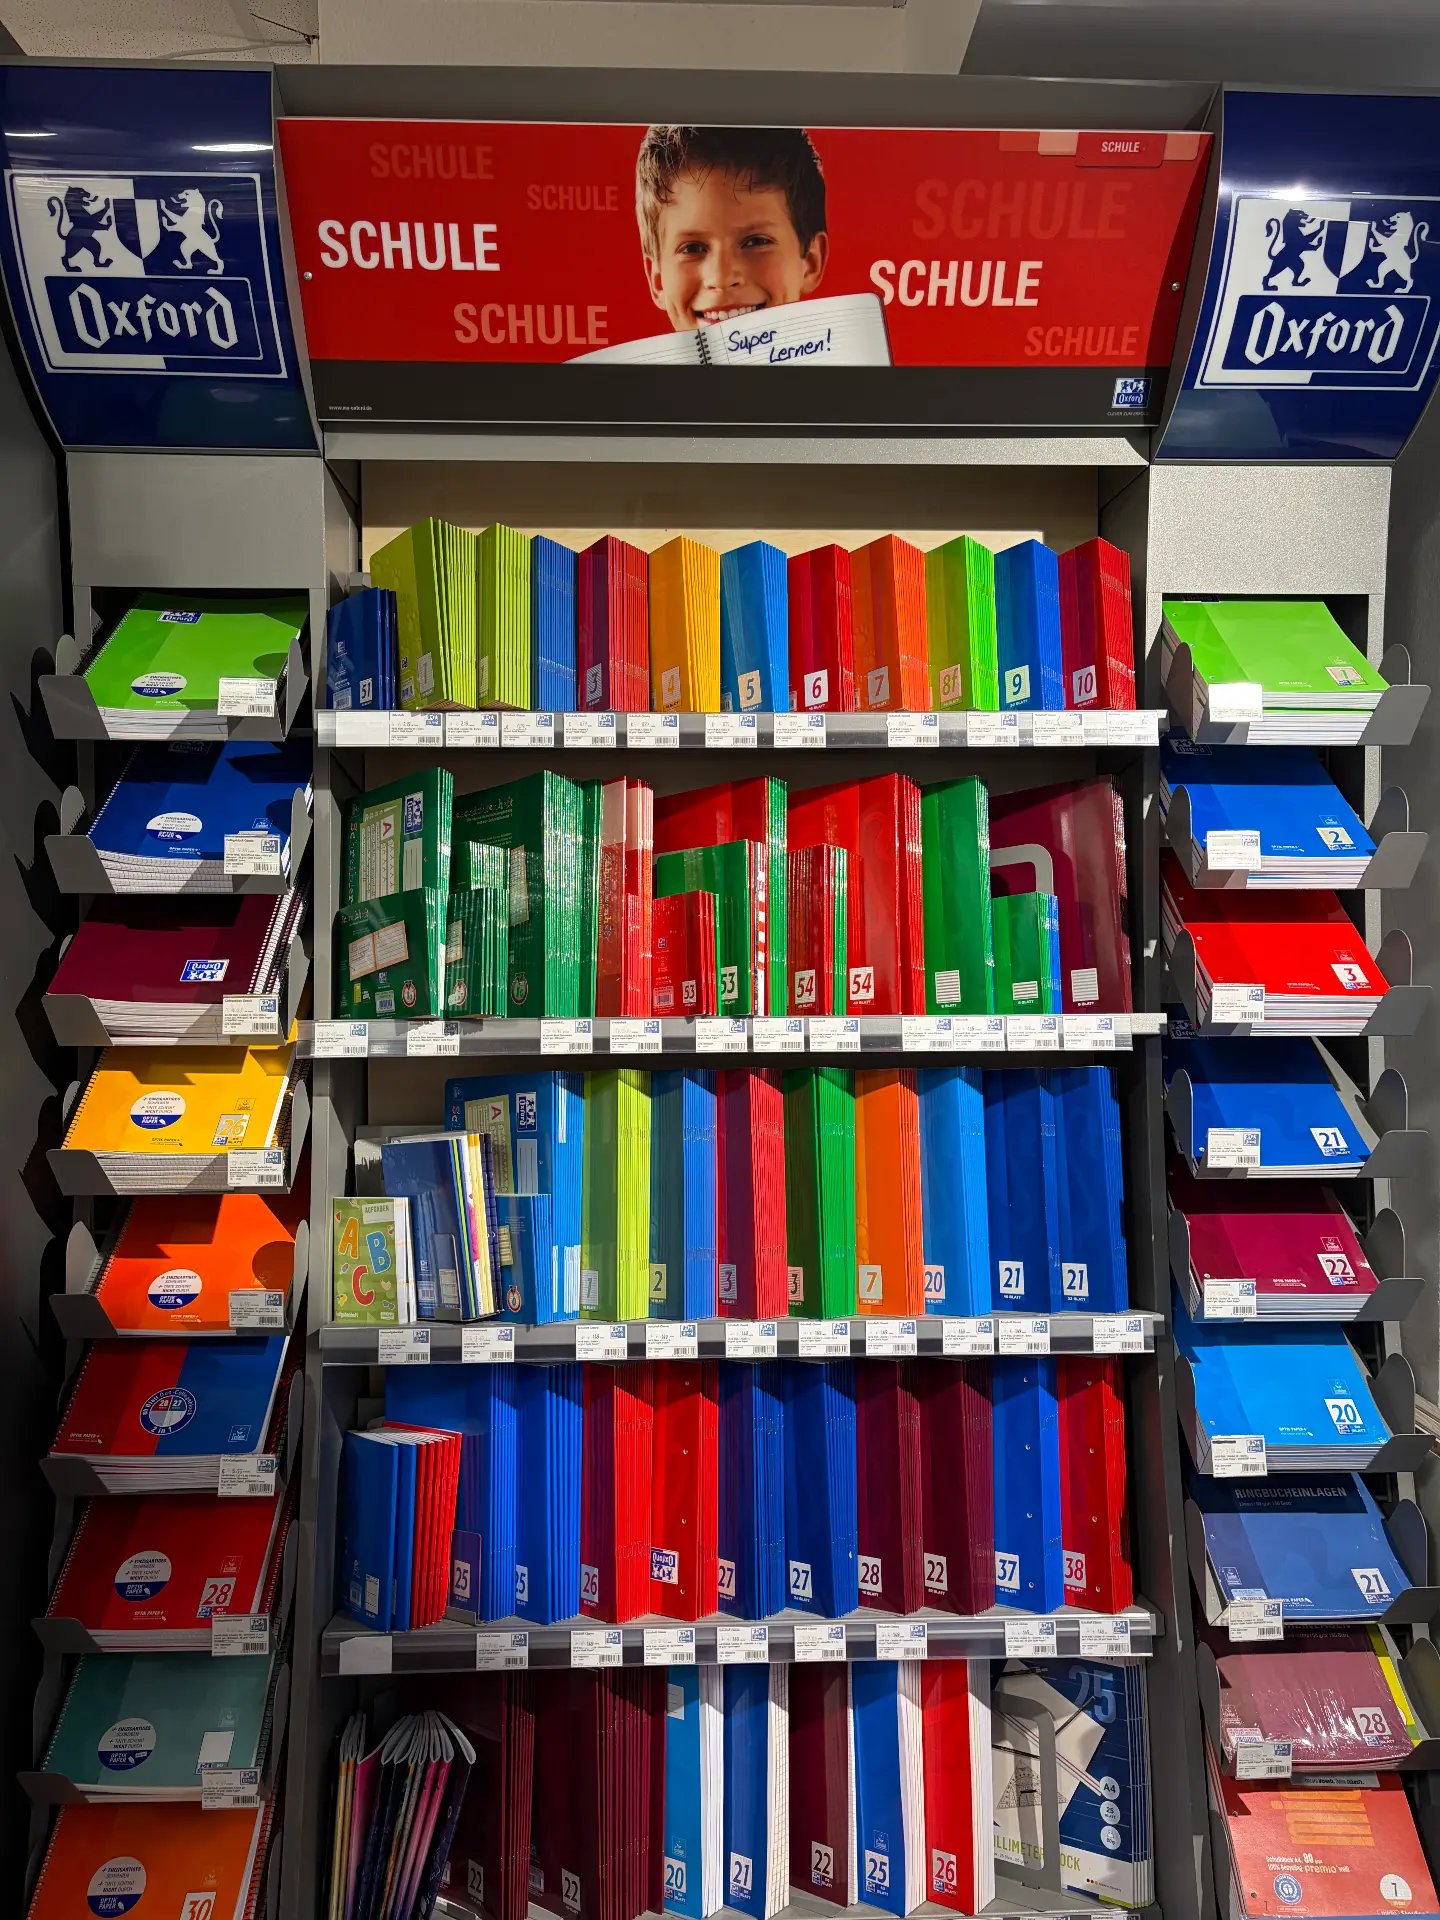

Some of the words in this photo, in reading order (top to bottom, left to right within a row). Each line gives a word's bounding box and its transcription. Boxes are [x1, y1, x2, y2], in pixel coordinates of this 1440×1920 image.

[1101, 140, 1141, 154] SCHULE
[368, 143, 494, 181] SCHULE
[526, 184, 620, 212] SCHULE
[911, 178, 1131, 240] SCHULE
[318, 219, 500, 271] SCHULE
[869, 258, 1043, 308] SCHULE
[68, 283, 239, 350] Oxford
[453, 301, 609, 345] SCHULE
[727, 329, 777, 356] Super
[769, 330, 832, 363] Lernen!
[1023, 324, 1140, 358] SCHULE
[1243, 304, 1405, 365] Oxford
[1118, 393, 1144, 404] Oxford
[361, 682, 371, 699] 51
[666, 675, 675, 696] 4
[746, 677, 755, 701] 5
[811, 676, 822, 699] 6
[874, 673, 885, 697] 7
[1012, 673, 1022, 696] 9
[1077, 671, 1094, 696] 10
[1328, 831, 1343, 844] 2
[192, 962, 221, 971] Oxford
[1343, 967, 1357, 982] 3
[684, 984, 695, 1000] 53
[720, 972, 736, 996] 53
[796, 975, 814, 998] 54
[851, 972, 872, 995] 54
[1176, 1029, 1197, 1037] Oxfor
[217, 1118, 247, 1136] 26
[1318, 1132, 1341, 1147] 21
[338, 1217, 360, 1260] A
[366, 1231, 391, 1274] B
[1003, 1266, 1021, 1289] 21
[1325, 1258, 1350, 1276] 22
[352, 1265, 375, 1306] C
[652, 1270, 663, 1292] 2
[723, 1270, 732, 1293] 3
[790, 1273, 799, 1295] 3
[866, 1271, 878, 1293] 7
[924, 1270, 943, 1293] 20
[1066, 1268, 1084, 1291] 21
[1331, 1404, 1357, 1423] 20
[1234, 1486, 1347, 1499] RINGBUCHEINLAGEN
[652, 1552, 674, 1567] Oxford
[926, 1559, 945, 1584] 22
[997, 1557, 1018, 1582] 37
[1064, 1556, 1084, 1581] 38
[455, 1566, 469, 1591] 25
[582, 1571, 598, 1596] 26
[717, 1565, 735, 1589] 27
[792, 1566, 810, 1591] 27
[860, 1562, 879, 1586] 28
[1359, 1573, 1384, 1593] 21
[201, 1583, 232, 1606] 28
[1359, 1713, 1386, 1735] 28
[1103, 1783, 1116, 1793] A4
[1105, 1806, 1114, 1815] 25
[732, 1860, 750, 1887] 21
[813, 1849, 832, 1876] 22
[867, 1857, 887, 1884] 25
[934, 1856, 955, 1883] 26
[470, 1867, 482, 1895] 22
[665, 1863, 685, 1890] 20
[563, 1876, 579, 1903] 22
[188, 1898, 213, 1920] 30
